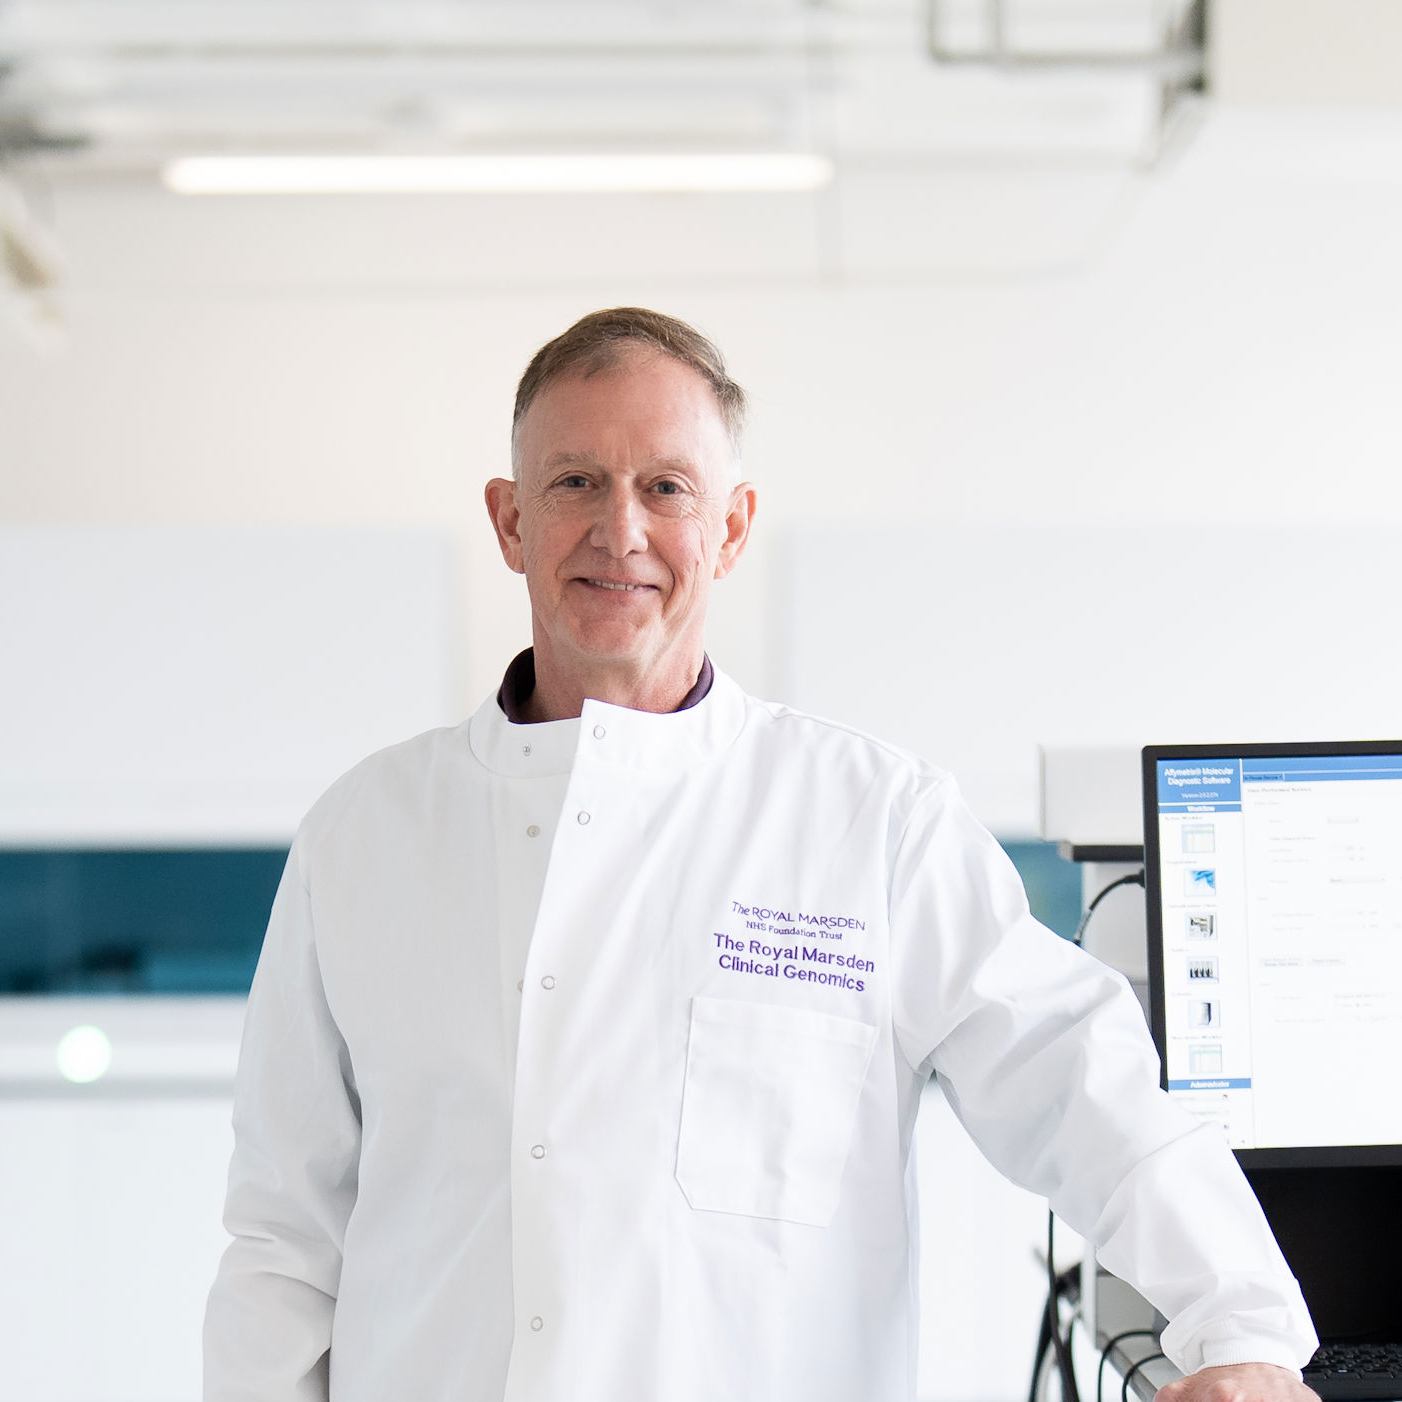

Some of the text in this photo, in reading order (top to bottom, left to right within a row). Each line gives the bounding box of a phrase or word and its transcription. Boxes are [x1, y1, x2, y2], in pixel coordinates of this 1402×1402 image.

[1202, 776, 1232, 785] Software
[732, 901, 866, 931] The ROYAL MARSDEN
[746, 921, 843, 940] NHS Foundation Trust
[713, 933, 875, 973] The Royal Marsden
[718, 954, 865, 992] Clinical Genomics
